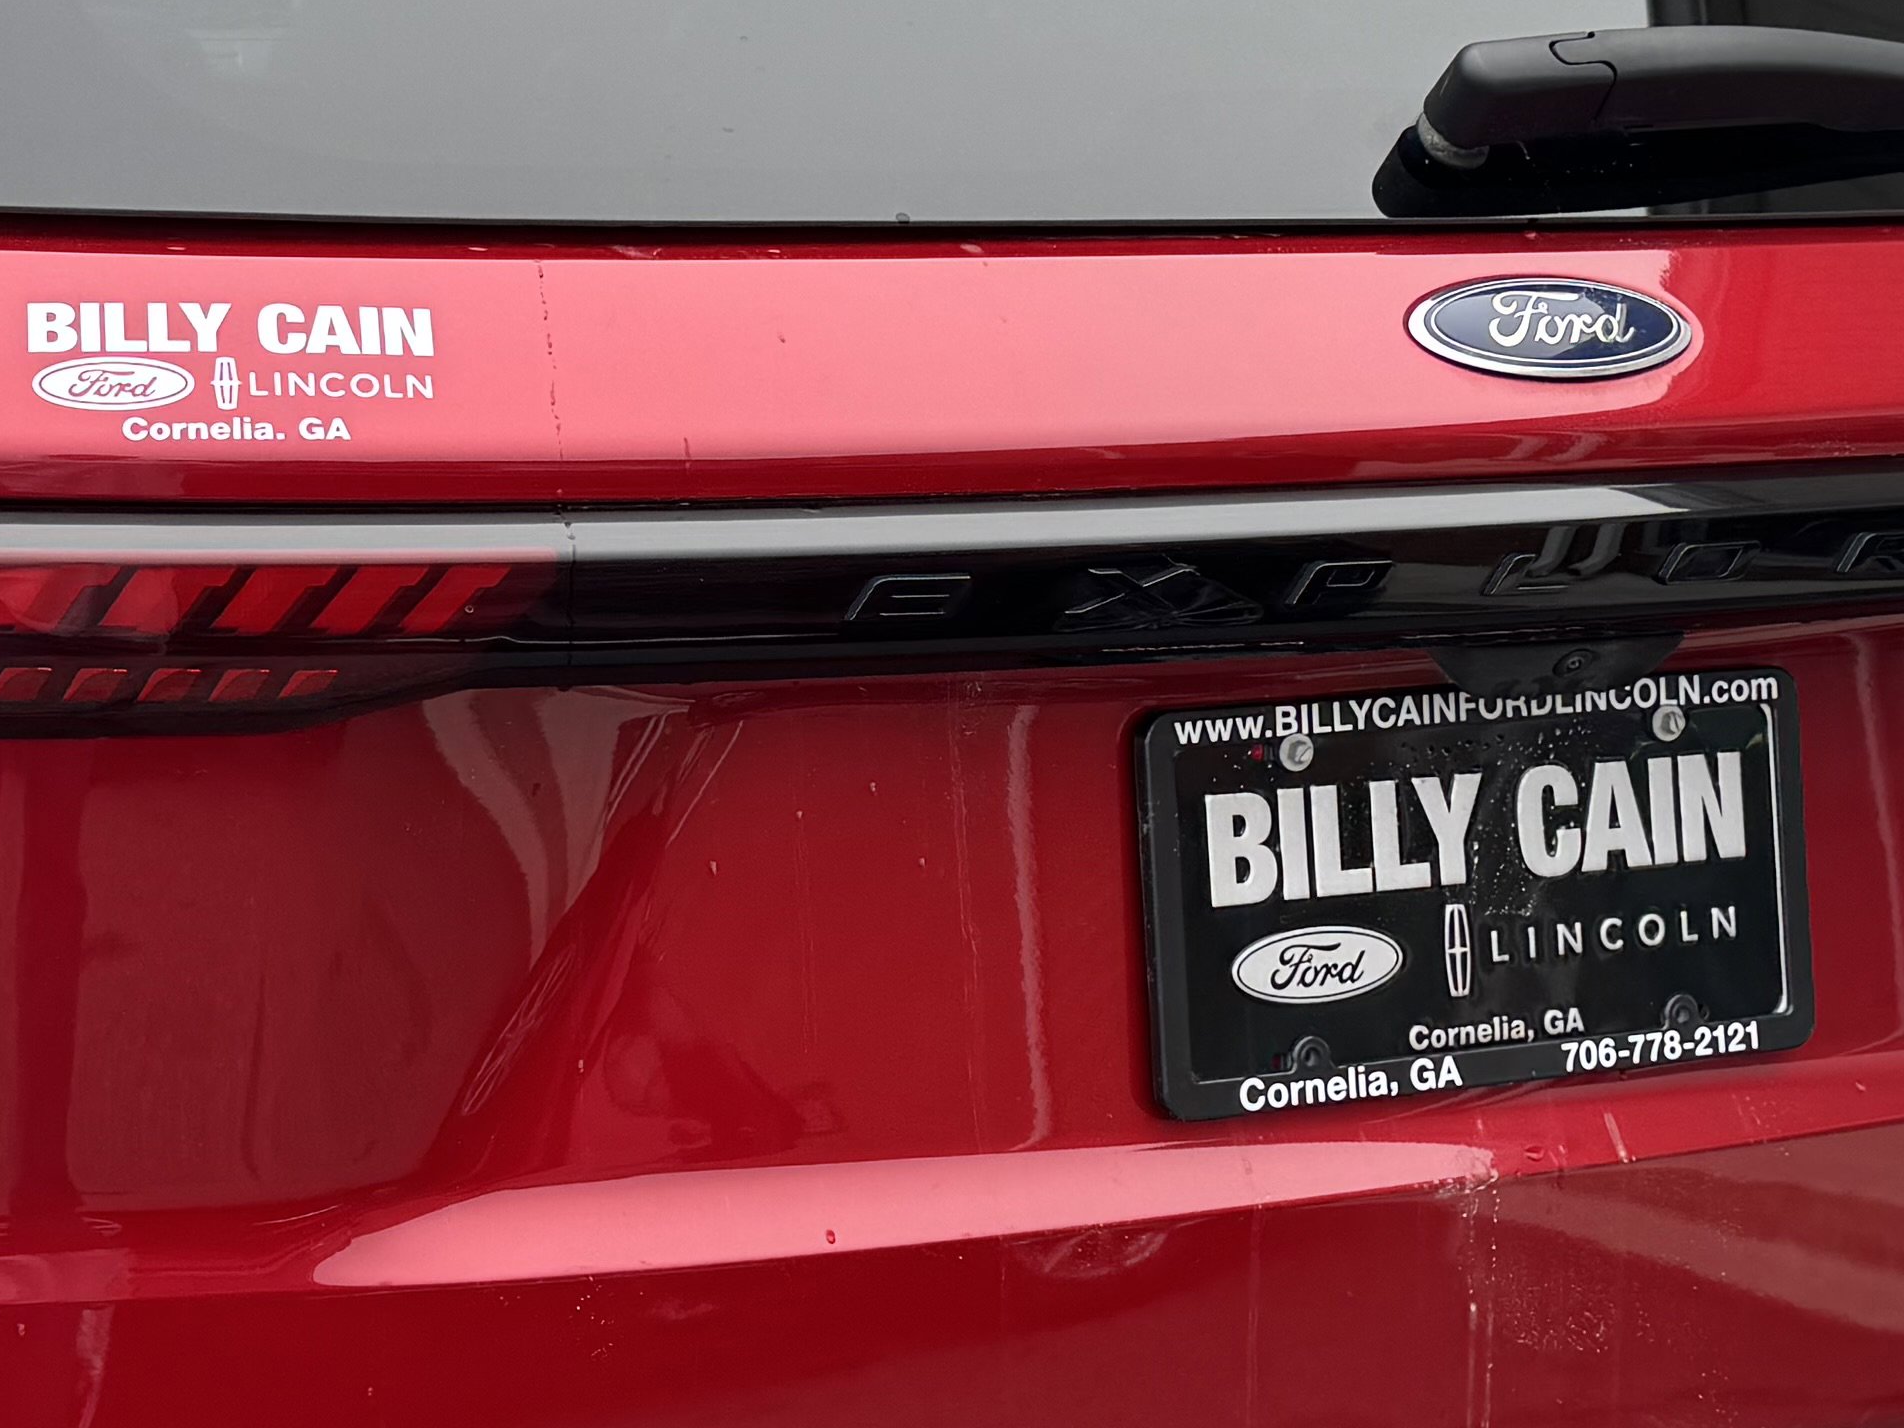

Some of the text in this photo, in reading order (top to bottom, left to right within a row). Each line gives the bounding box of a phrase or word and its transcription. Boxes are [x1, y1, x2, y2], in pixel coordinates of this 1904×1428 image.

[26, 302, 435, 356] BILLY CAIN
[1489, 290, 1635, 348] Ford
[68, 369, 156, 399] Ford
[249, 371, 435, 399] LINCOLN
[298, 417, 351, 441] GA
[1204, 751, 1747, 907] BILLY CAIN
[1490, 905, 1739, 964] LINCOLN
[1270, 943, 1365, 987] Ford
[1408, 1007, 1585, 1052] Cornelia, GA
[1561, 1020, 1761, 1074] 706-778-2121
[1239, 1057, 1463, 1112] Cornelia, GA
